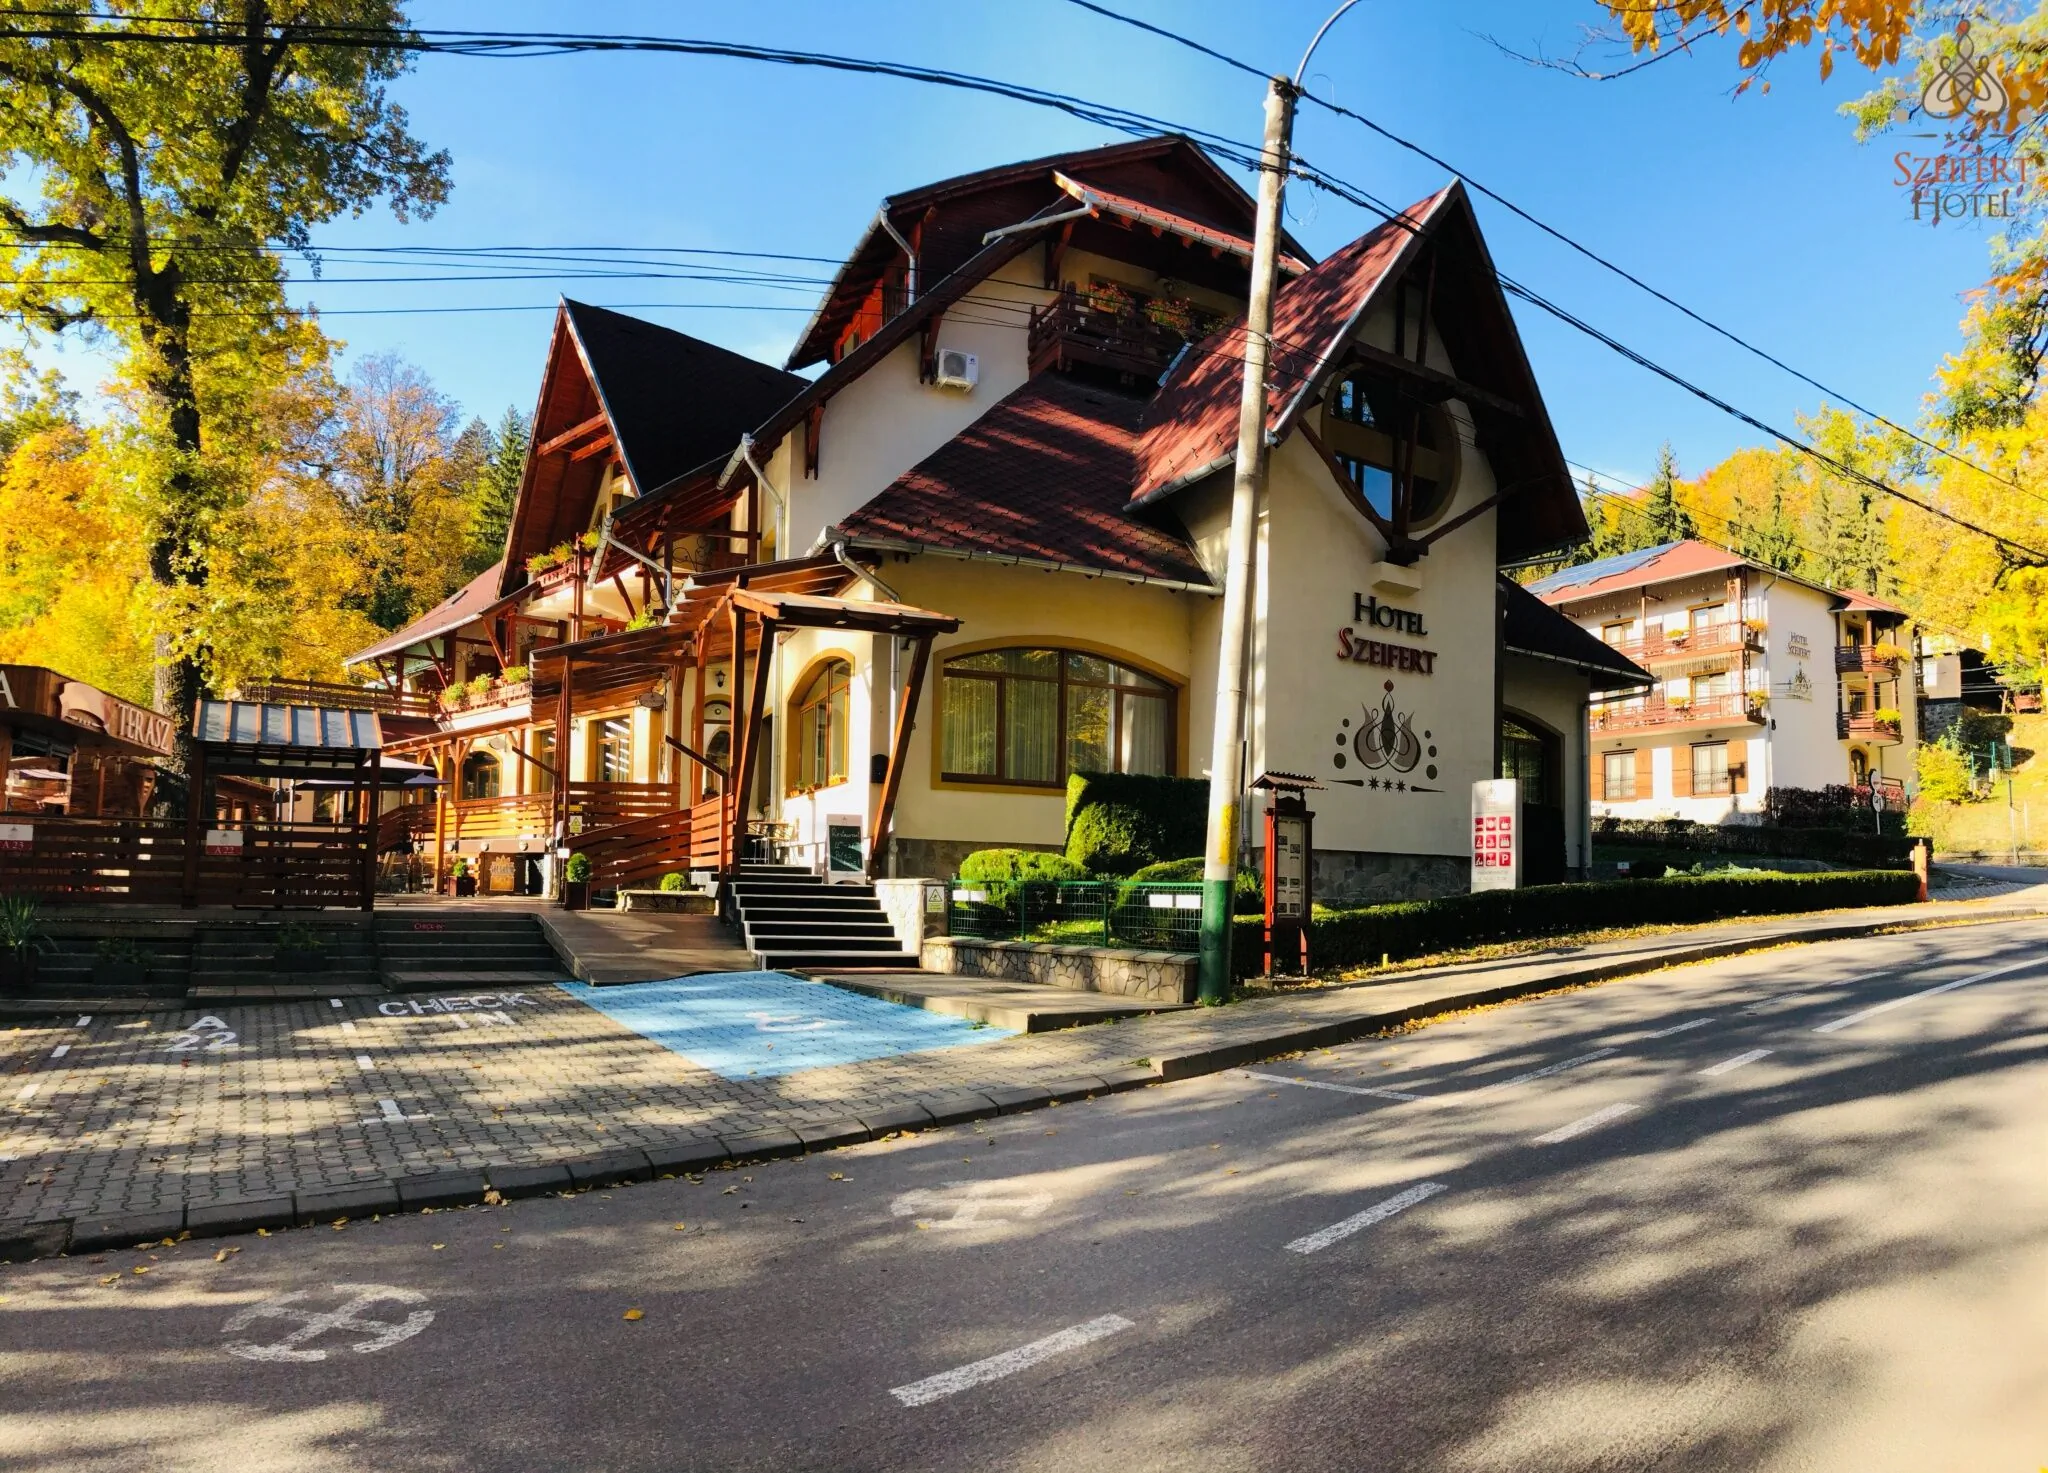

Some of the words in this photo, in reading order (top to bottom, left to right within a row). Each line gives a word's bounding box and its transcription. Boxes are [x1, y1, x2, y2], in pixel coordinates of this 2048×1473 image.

[1353, 591, 1428, 636] HOTEL
[1336, 627, 1438, 676] SZEIFERT
[117, 703, 170, 751] TERASZ
[378, 992, 539, 1016] CHECK
[450, 1010, 516, 1029] IN
[163, 1031, 237, 1052] 22
